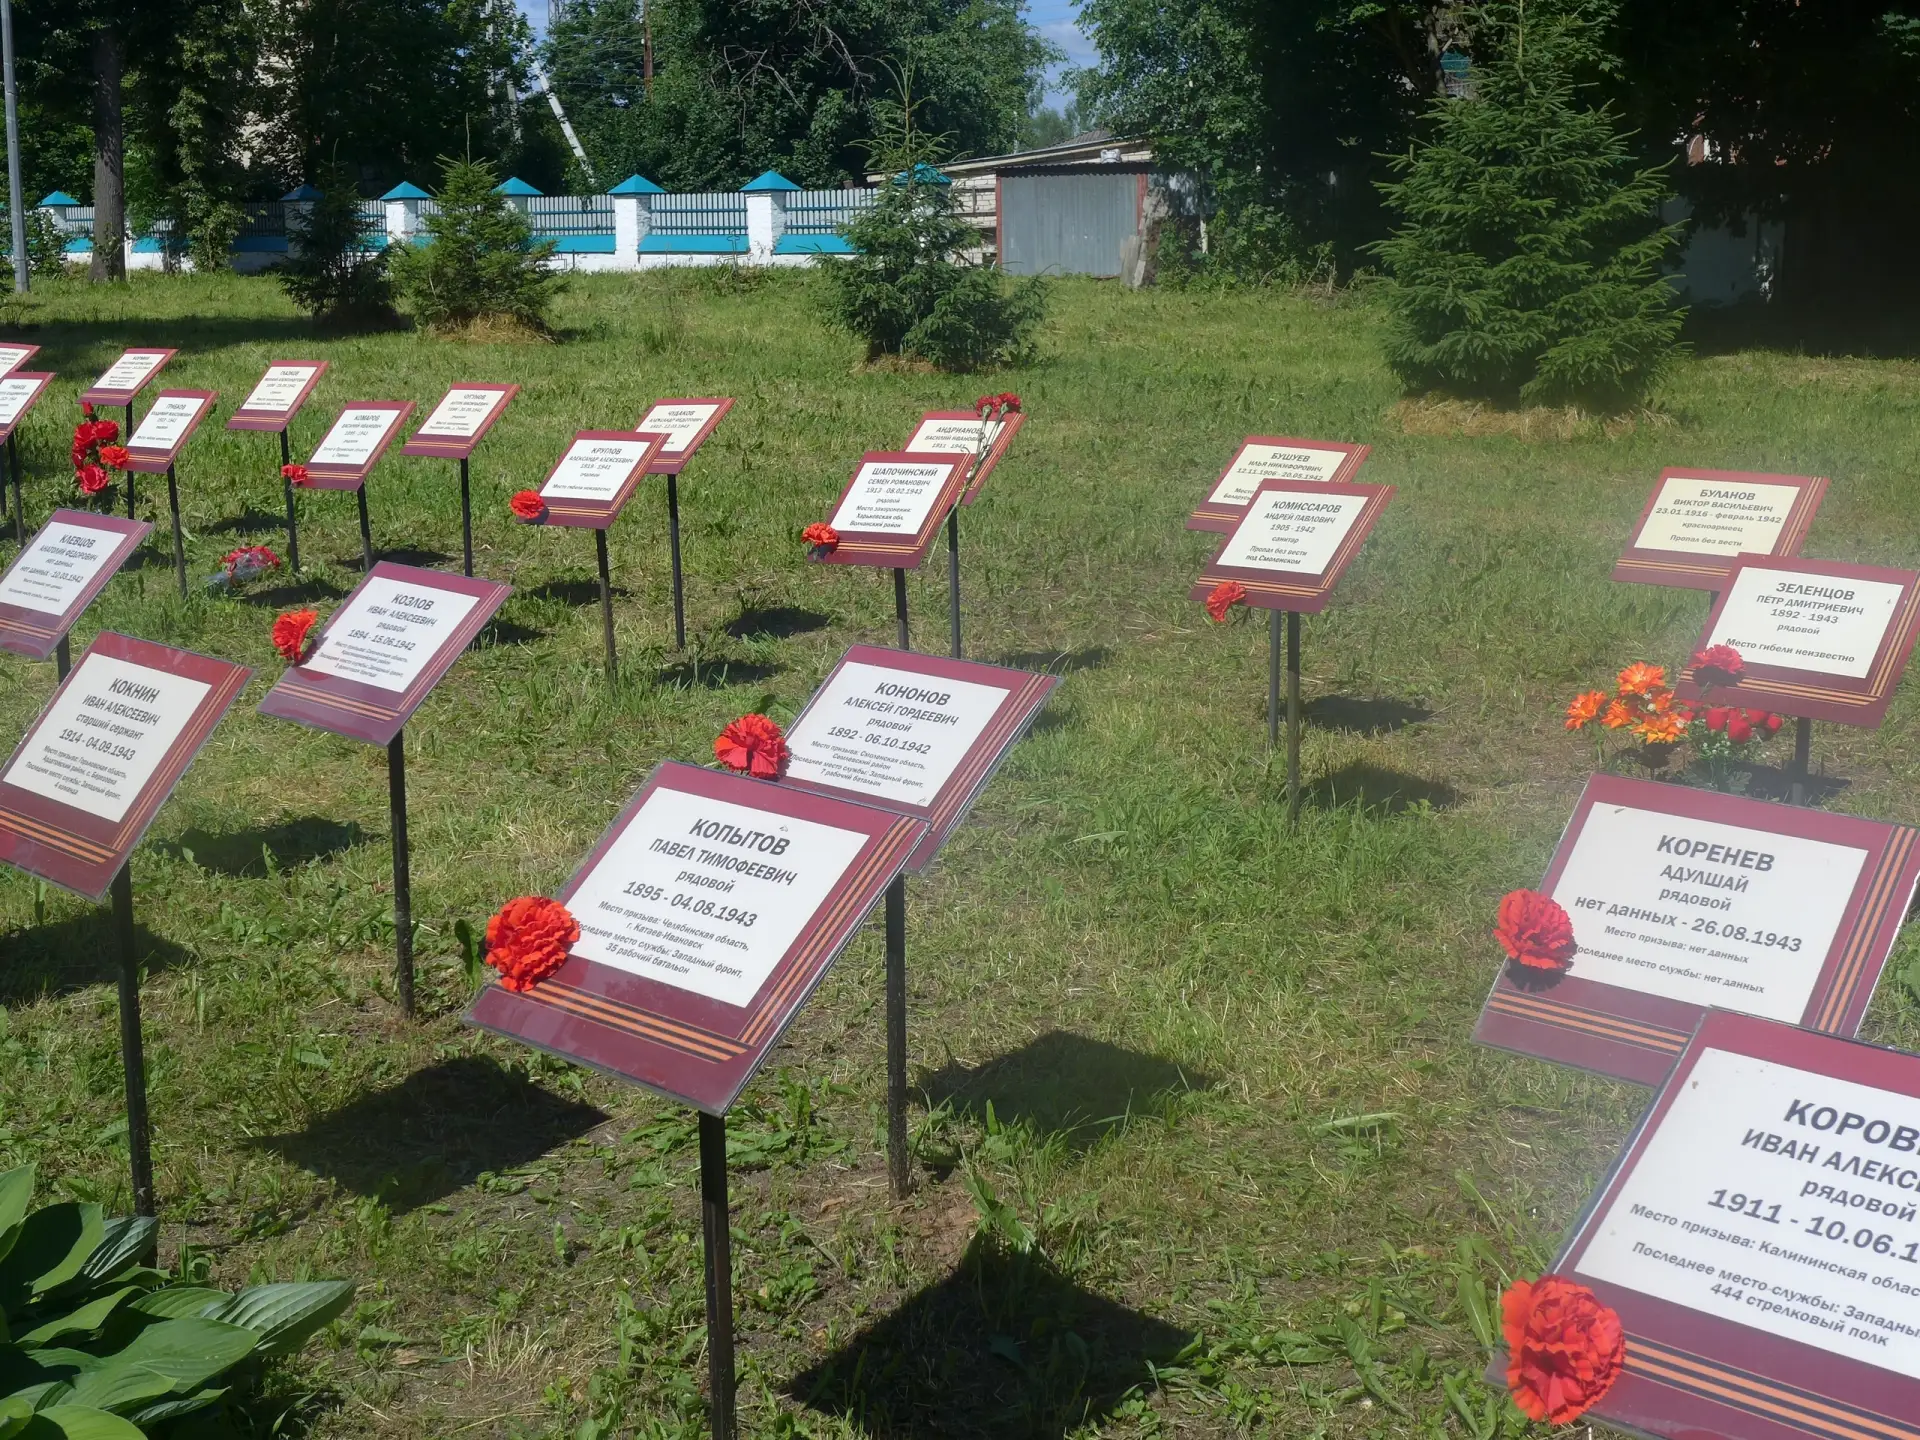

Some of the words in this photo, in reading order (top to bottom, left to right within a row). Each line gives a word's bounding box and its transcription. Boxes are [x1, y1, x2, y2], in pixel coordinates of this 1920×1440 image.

[1271, 452, 1311, 462] БУШУЕВ
[872, 468, 938, 476] ШАПОЧИНСКИЙ
[1272, 500, 1342, 513] КОМИССАРОВ
[1673, 498, 1710, 507] ВИКТОР
[1711, 501, 1773, 512] ВАСИЛЬЕВИЧ
[1699, 489, 1756, 500] БУЛАНОВ
[1264, 512, 1294, 520] АНДРЕЙ
[1294, 514, 1336, 524] ПАВЛОВИЧ
[1270, 523, 1291, 531] 1905
[1294, 525, 1316, 533] 1942
[1682, 522, 1743, 532] красноармеец
[59, 534, 96, 548] КЛЕВЦОВ
[1669, 534, 1700, 542] Пропал
[391, 593, 434, 610] КОЗЛОВ
[1776, 582, 1855, 600] ЗЕЛЕНЦОВ
[366, 606, 389, 616] ИВАН
[388, 610, 437, 626] АЛЕКСЕЕВИЧ
[1770, 608, 1800, 619] 1892
[1808, 613, 1839, 624] 1943
[1784, 598, 1864, 615] ДМИТРИЕВИЧ
[376, 622, 407, 632] рядовой
[1776, 624, 1820, 635] рядовой
[1725, 638, 1757, 648] Место
[1758, 643, 1793, 654] гибели
[1795, 649, 1855, 662] неизвестно
[108, 678, 160, 704] КОКНИН
[874, 682, 951, 706] КОНОНОВ
[82, 694, 108, 710] ИВАН
[104, 701, 161, 726] АЛЕКСЕЕВИЧ
[843, 696, 895, 713] АЛЕКСЕЙ
[893, 705, 959, 726] ГОРДЕЕВИЧ
[76, 713, 111, 730] старший
[109, 724, 144, 740] сержант
[866, 718, 912, 732] рядовой
[59, 728, 83, 744] 1914
[85, 736, 136, 761] 04.09.1943
[827, 726, 858, 740] 1892
[864, 733, 931, 754] 06.10.1942
[688, 818, 790, 856] КОПЫТОВ
[649, 838, 696, 860] ПАВЕЛ
[696, 849, 798, 886] ТИМОФЕЕВИЧ
[1656, 834, 1775, 871] КОРЕНЕВ
[674, 871, 736, 893] рядовой
[1659, 864, 1749, 893] АДУЛШАЙ
[622, 881, 664, 901] 1895
[670, 893, 758, 927] 04.08.1943
[1658, 888, 1731, 911] рядовой
[598, 900, 624, 914] Место
[622, 909, 661, 924] призыва:
[662, 918, 715, 940] Челябинская
[714, 935, 749, 951] область,
[633, 923, 704, 950] Катаев-Ивановск
[1574, 896, 1606, 911] нет
[1606, 903, 1678, 927] данных
[1691, 918, 1802, 952] 26.08.1943
[577, 923, 613, 938] оследнее
[611, 934, 638, 946] место
[633, 941, 672, 957] службы:
[671, 949, 715, 968] Западный
[715, 963, 742, 978] фронт,
[1604, 925, 1637, 939] Место
[1638, 934, 1687, 950] призыва:
[1688, 945, 1707, 954] нет
[1707, 949, 1749, 963] данных
[605, 942, 619, 952] 35
[616, 947, 653, 962] рабочий
[651, 956, 690, 974] батальон
[1575, 946, 1624, 962] оследнее
[1625, 957, 1657, 969] место
[1658, 964, 1702, 979] службы:
[1703, 974, 1723, 984] нет
[1722, 979, 1764, 993] данных
[1783, 1099, 1920, 1156] КОРОВ
[1741, 1128, 1820, 1164] ИВАН
[1822, 1151, 1920, 1193] АЛЕКС
[1707, 1189, 1782, 1224] 1911
[1799, 1180, 1917, 1222] рядовой
[1630, 1203, 1678, 1226] Место
[1681, 1220, 1756, 1248] призыва:
[1758, 1240, 1868, 1281] Калининская
[1632, 1241, 1715, 1275] Последнее
[1718, 1270, 1768, 1291] место
[1771, 1286, 1840, 1313] службы:
[1843, 1305, 1920, 1339] Западны
[1710, 1283, 1743, 1301] 444
[1746, 1296, 1845, 1332] стрелковый
[1848, 1327, 1888, 1346] полк
